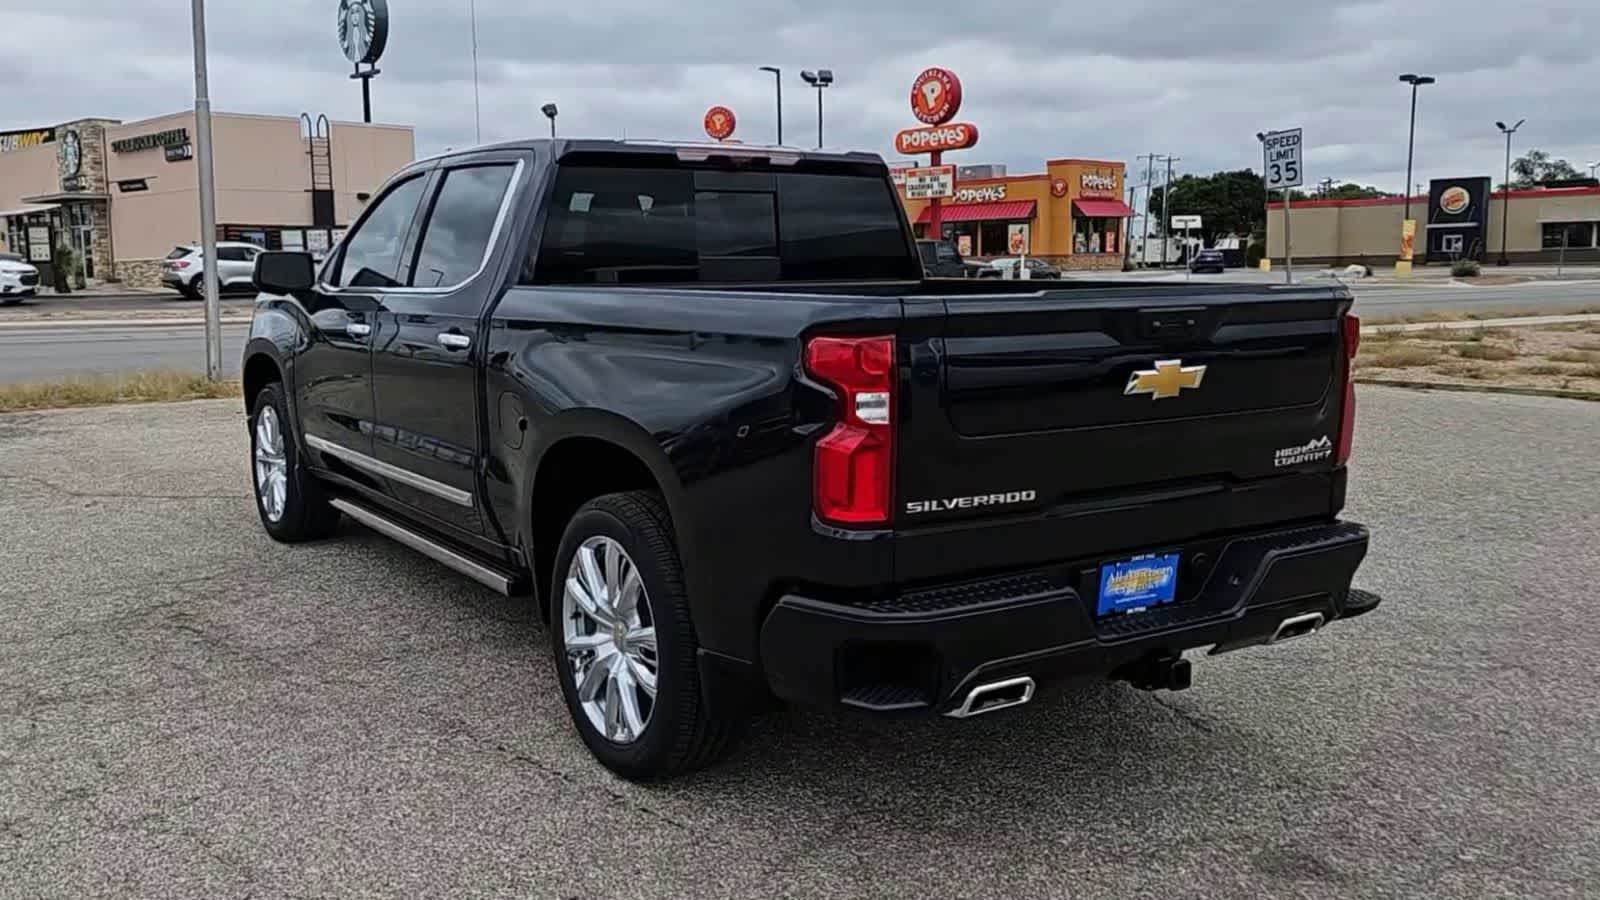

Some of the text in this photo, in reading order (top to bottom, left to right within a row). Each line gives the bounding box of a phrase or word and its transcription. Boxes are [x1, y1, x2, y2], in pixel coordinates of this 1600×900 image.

[1266, 134, 1300, 150] SPEED
[1270, 148, 1295, 162] LIMIT
[1270, 161, 1298, 184] 35
[1274, 449, 1332, 467] COUNTRY
[1275, 446, 1306, 458] HIGH
[905, 490, 1036, 514] SILVERADO
